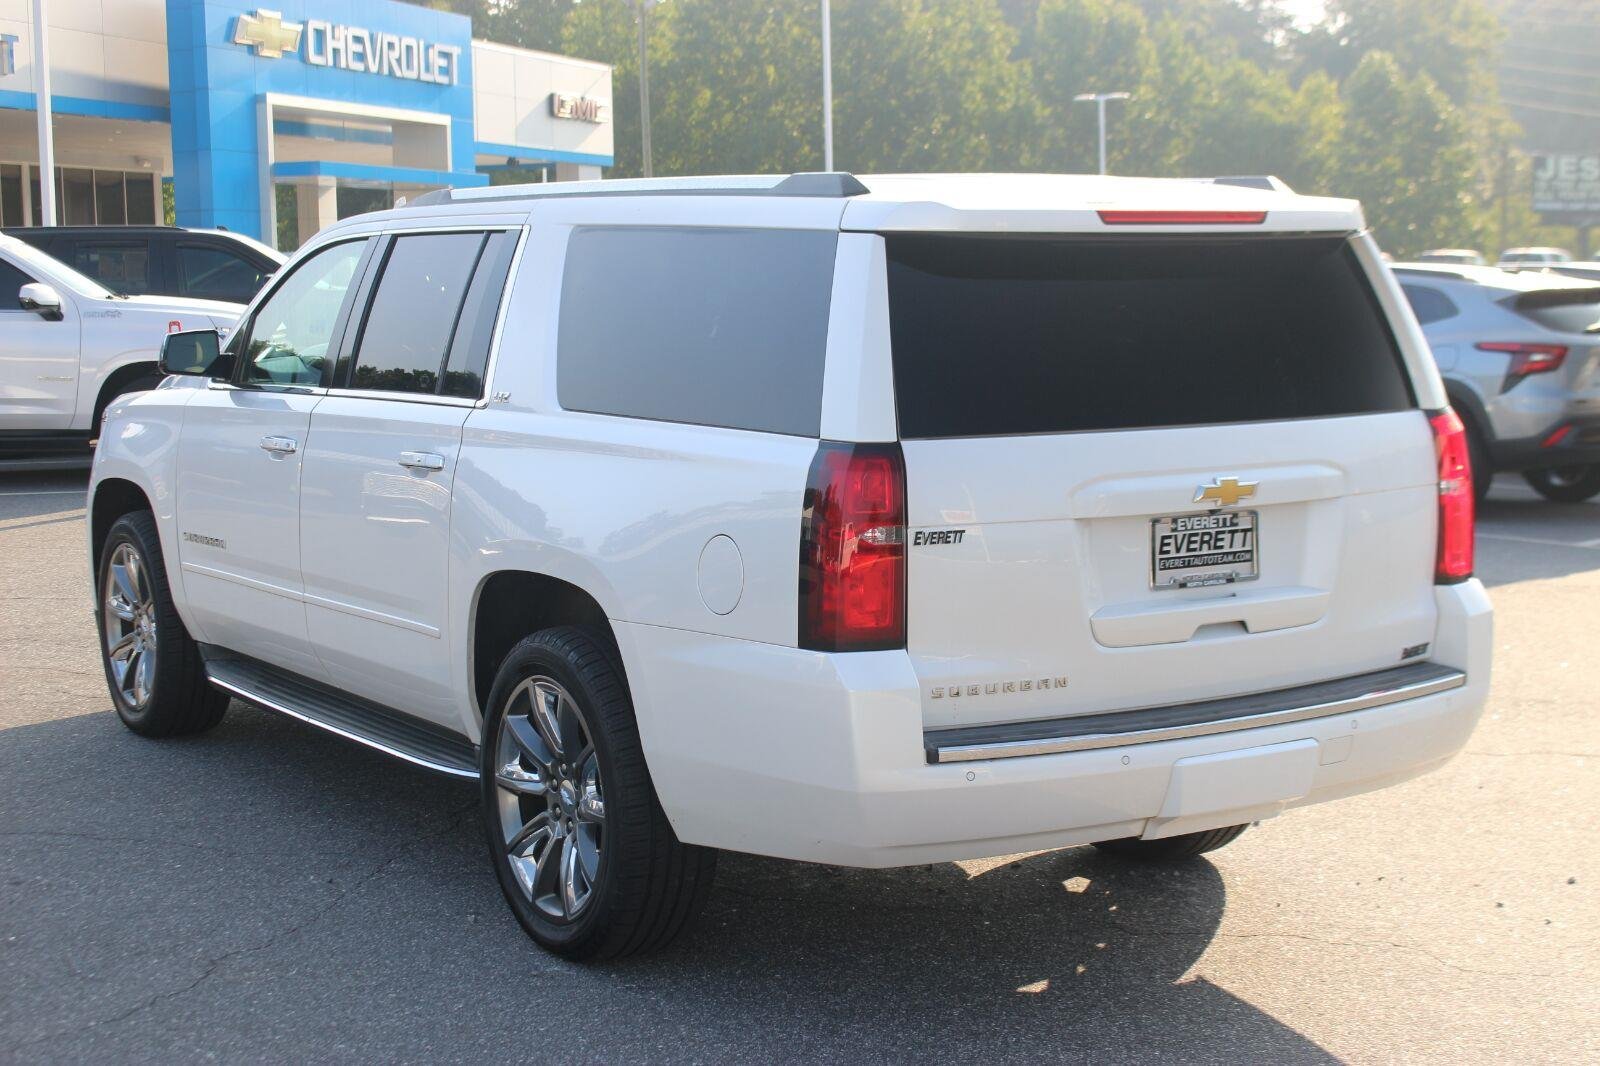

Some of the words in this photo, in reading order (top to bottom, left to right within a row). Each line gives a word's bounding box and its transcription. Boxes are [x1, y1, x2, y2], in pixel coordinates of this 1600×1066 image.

[307, 19, 461, 86] CHEVROLET
[1177, 514, 1233, 531] EVERETT
[913, 530, 966, 546] EVERETT
[1158, 527, 1252, 555] EVERETT
[931, 677, 1068, 698] SUBURBAN
